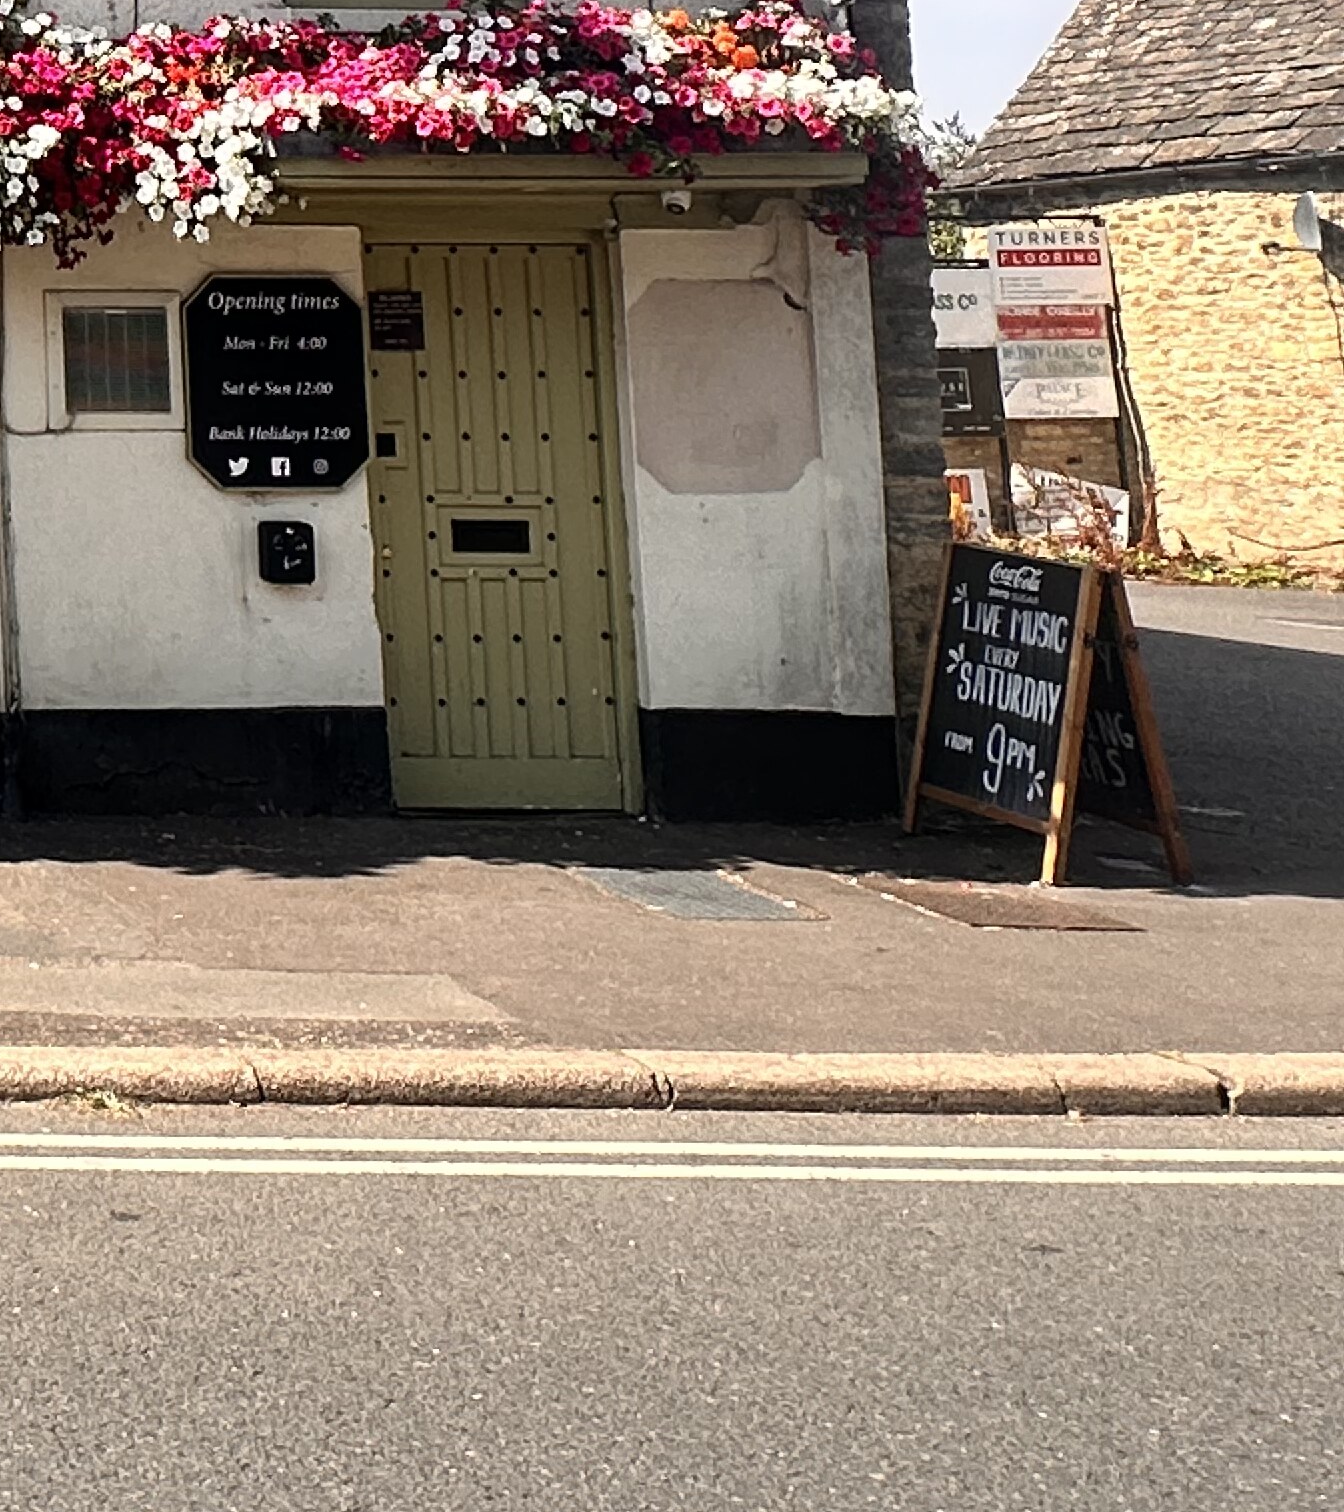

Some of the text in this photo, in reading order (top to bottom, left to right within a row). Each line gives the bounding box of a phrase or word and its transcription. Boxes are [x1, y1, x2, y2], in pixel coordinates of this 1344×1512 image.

[994, 230, 1100, 246] TURNERS
[999, 251, 1098, 264] FLOORING
[208, 291, 340, 315] Opening times
[223, 336, 256, 350] Mon
[268, 335, 290, 350] Fri
[296, 336, 328, 350] 4:00
[221, 381, 334, 396] Sat & Sun 12:00
[209, 425, 351, 444] Bank Holidays 12:00
[962, 600, 1069, 654] LIVE MUSIC
[984, 644, 1020, 670] EVERY
[956, 661, 1062, 727] SATURDAY
[944, 730, 974, 754] FROM
